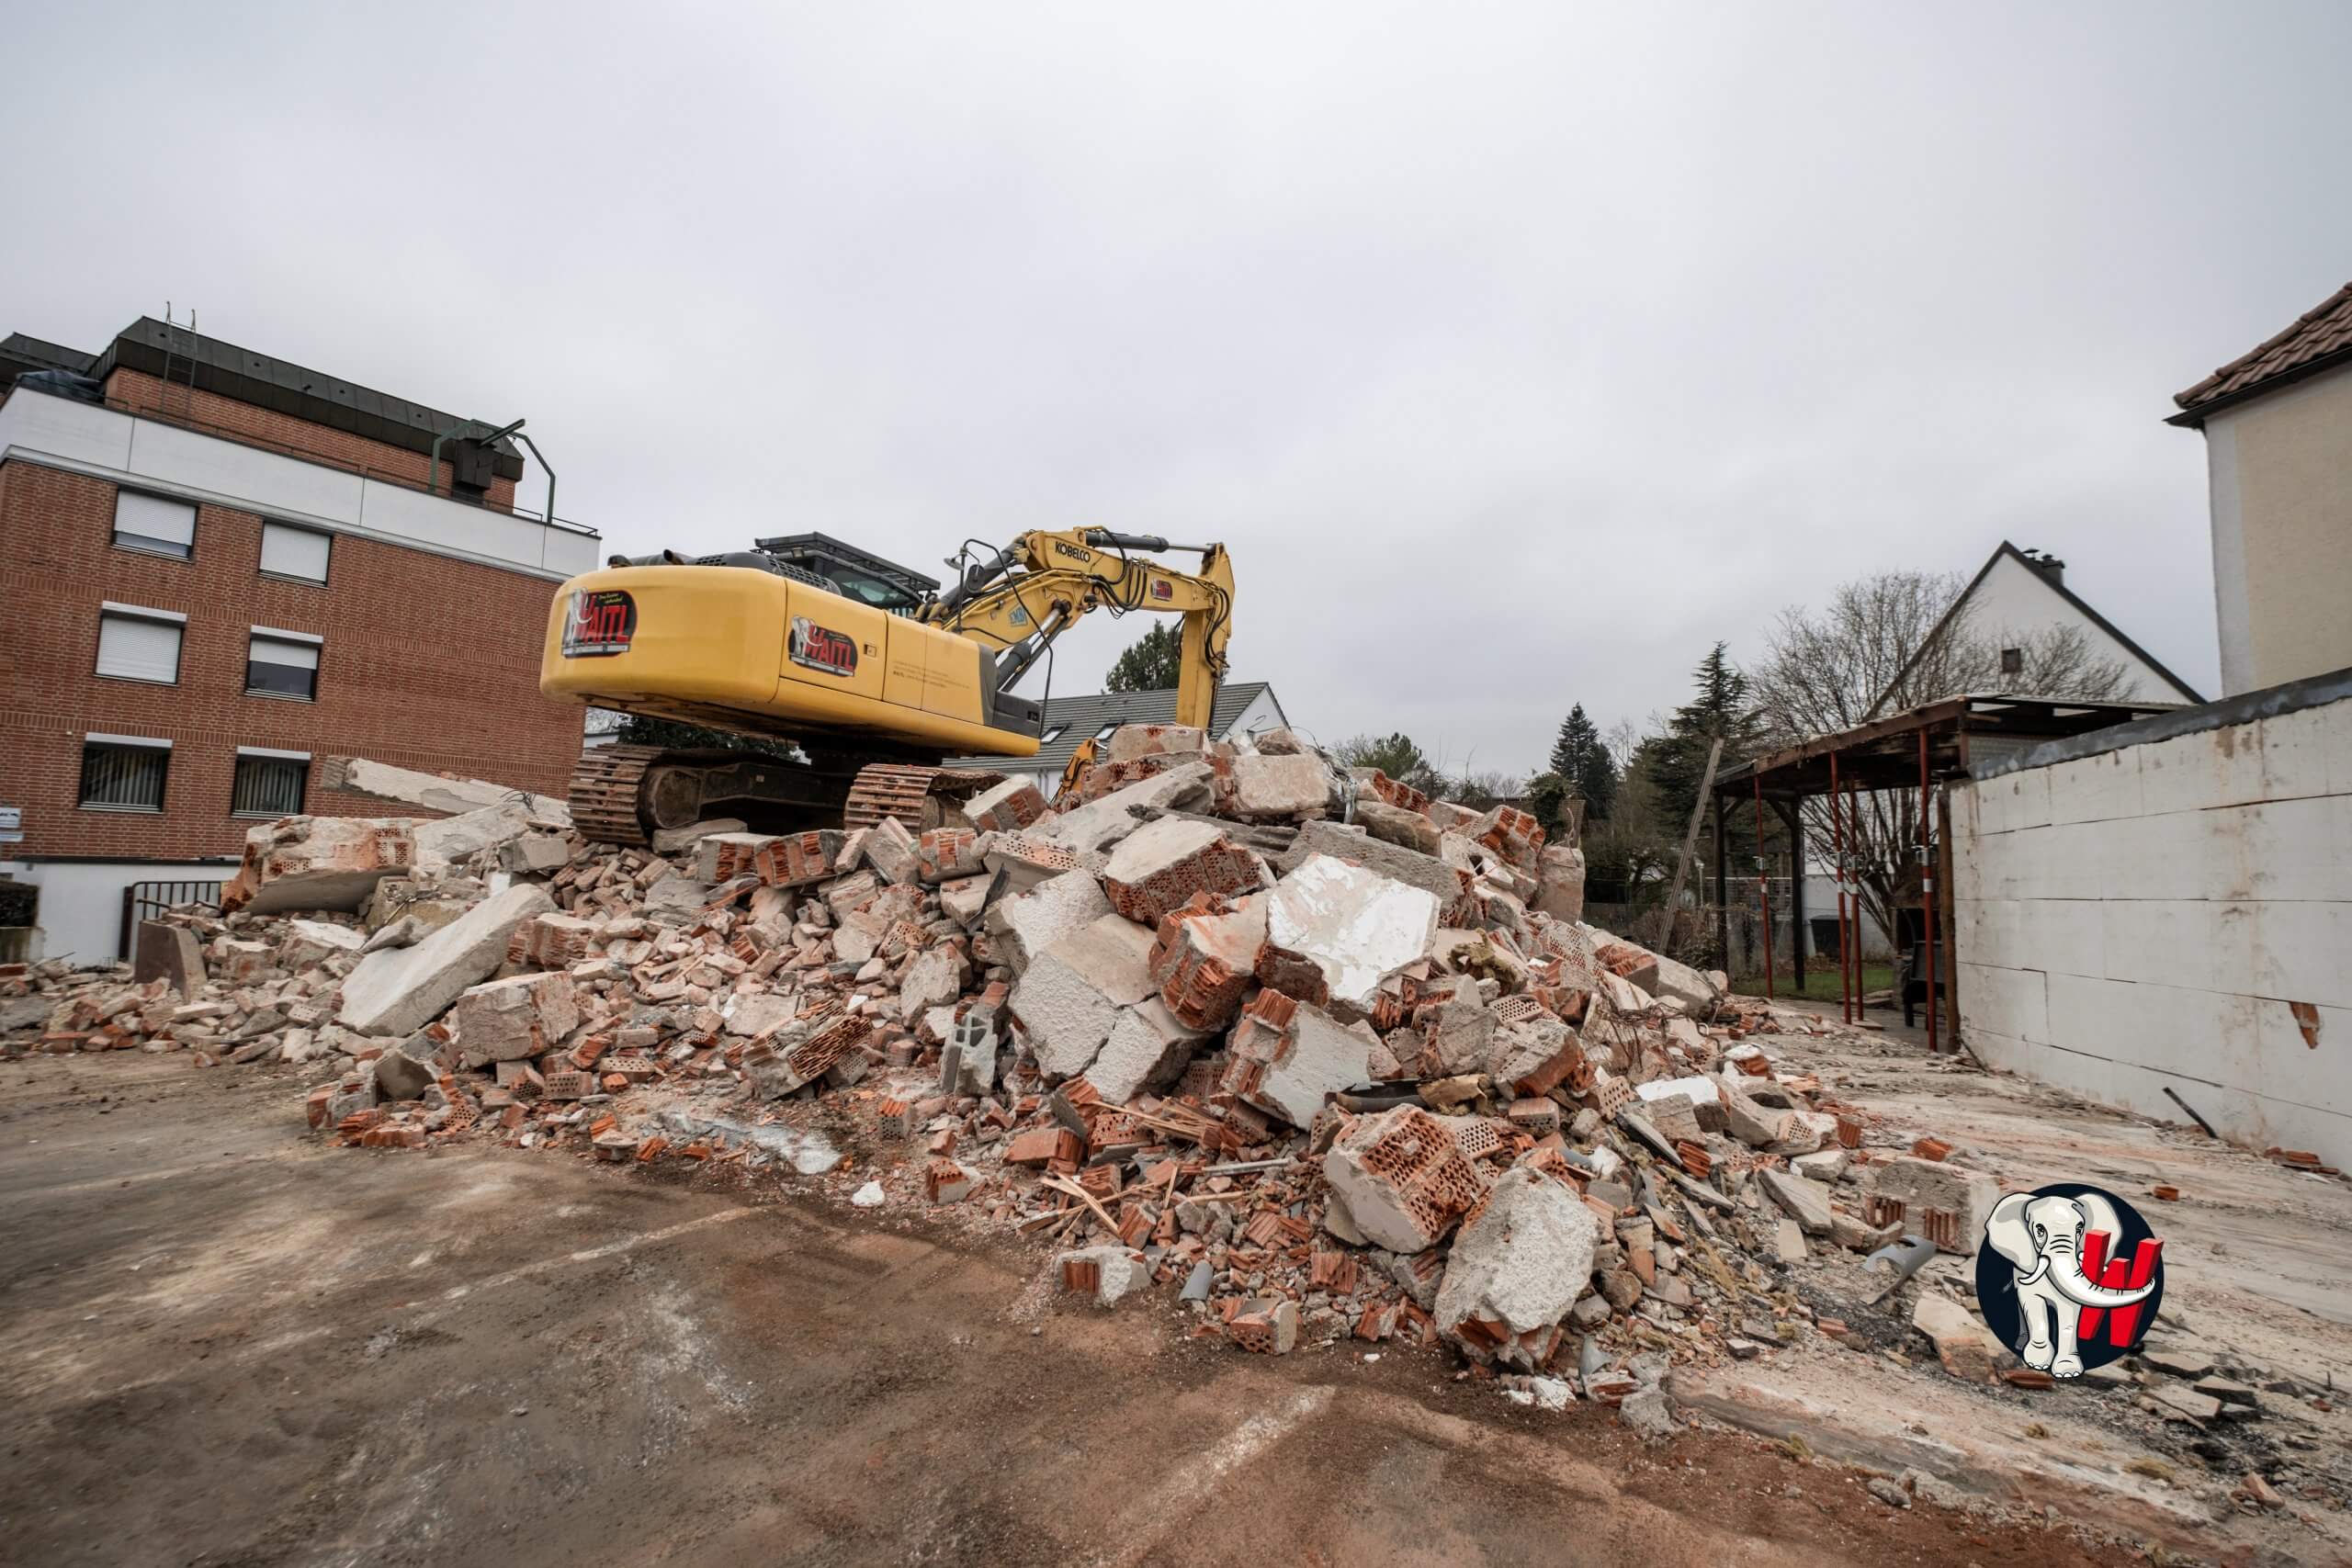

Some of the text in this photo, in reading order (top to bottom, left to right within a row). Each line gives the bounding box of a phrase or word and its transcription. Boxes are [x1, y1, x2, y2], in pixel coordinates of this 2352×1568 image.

[1055, 541, 1091, 562] KOBELCO
[574, 592, 630, 645] WAITL
[804, 625, 854, 671] WAITL
